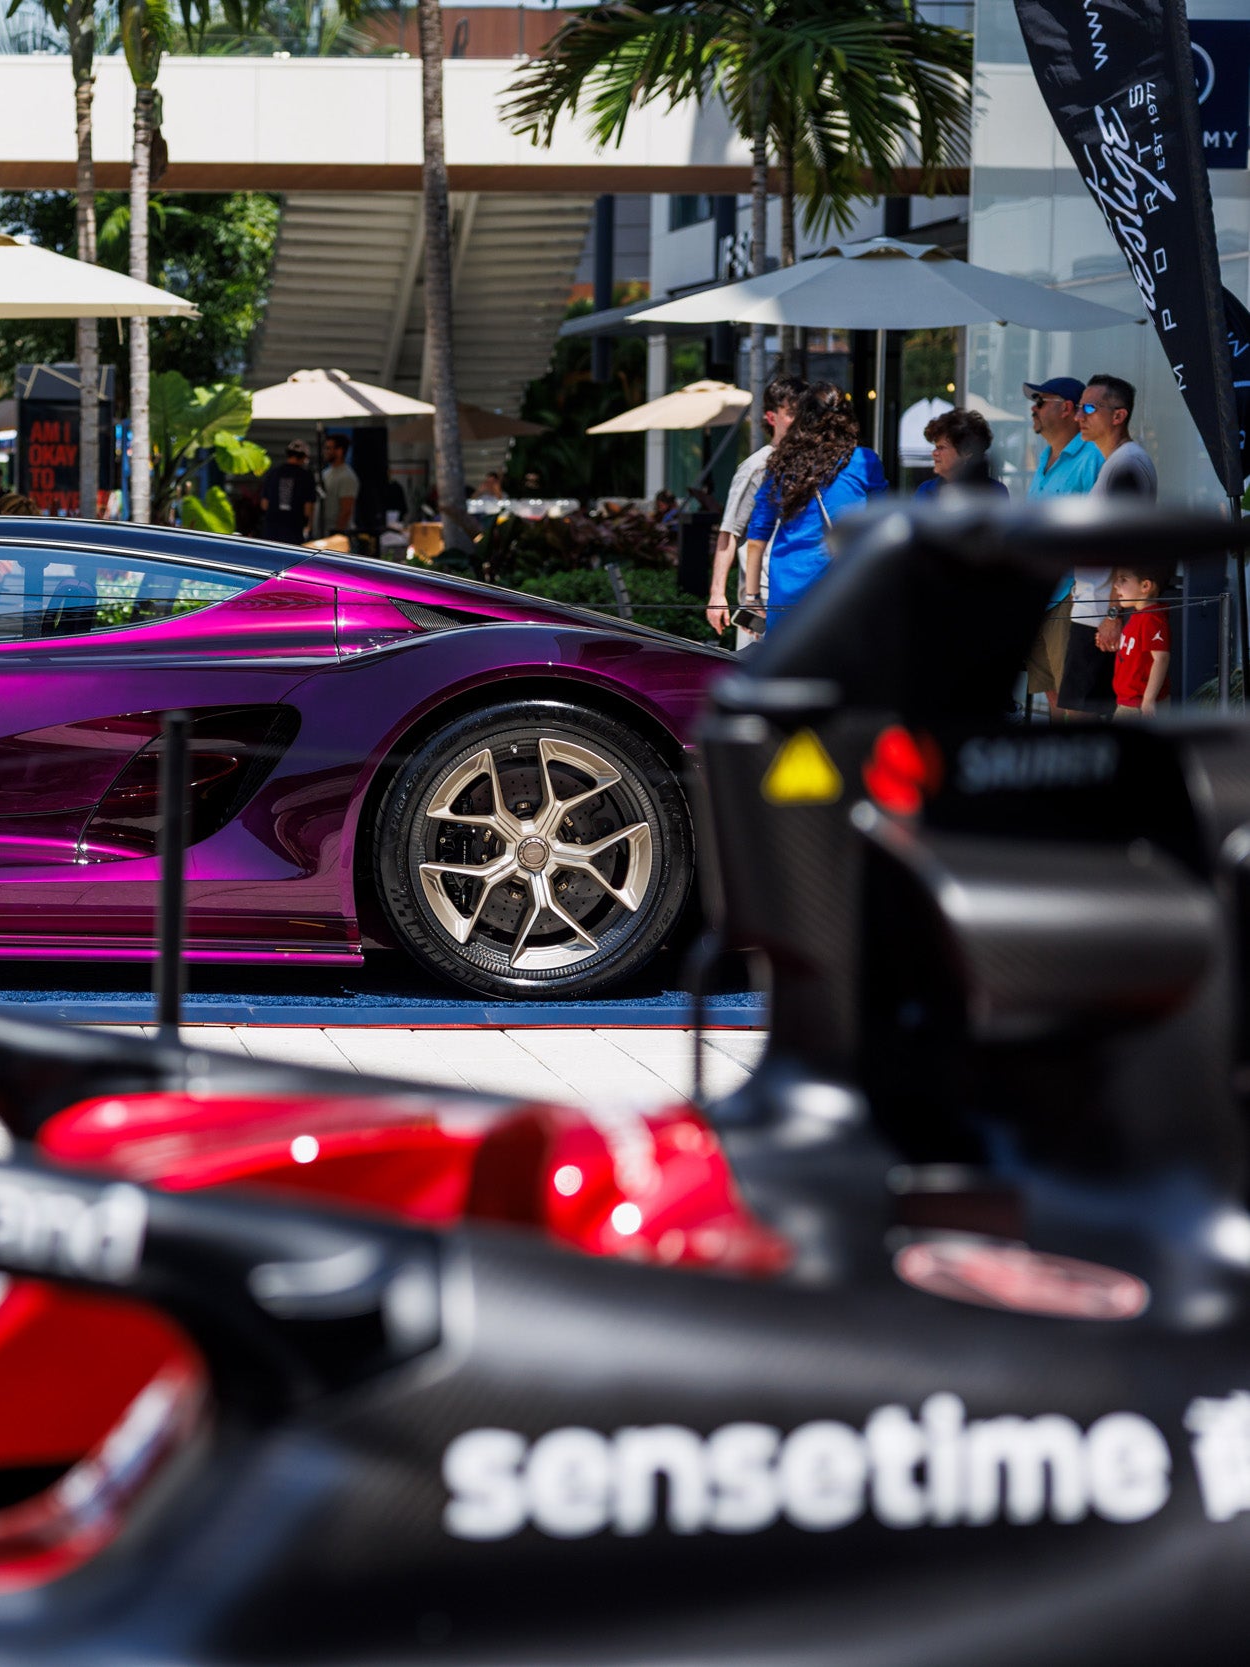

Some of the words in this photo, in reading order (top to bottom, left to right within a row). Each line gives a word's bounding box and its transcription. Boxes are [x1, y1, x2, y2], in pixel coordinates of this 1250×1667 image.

[1084, 0, 1108, 70] WW
[1146, 81, 1160, 125] 1977
[1153, 132, 1166, 170] EST
[30, 420, 61, 442] AM
[63, 421, 71, 442] I
[28, 444, 78, 467] OKAY
[29, 467, 56, 490] TO
[403, 918, 494, 993] MICHELIN
[442, 1391, 1172, 1540] sensetime
